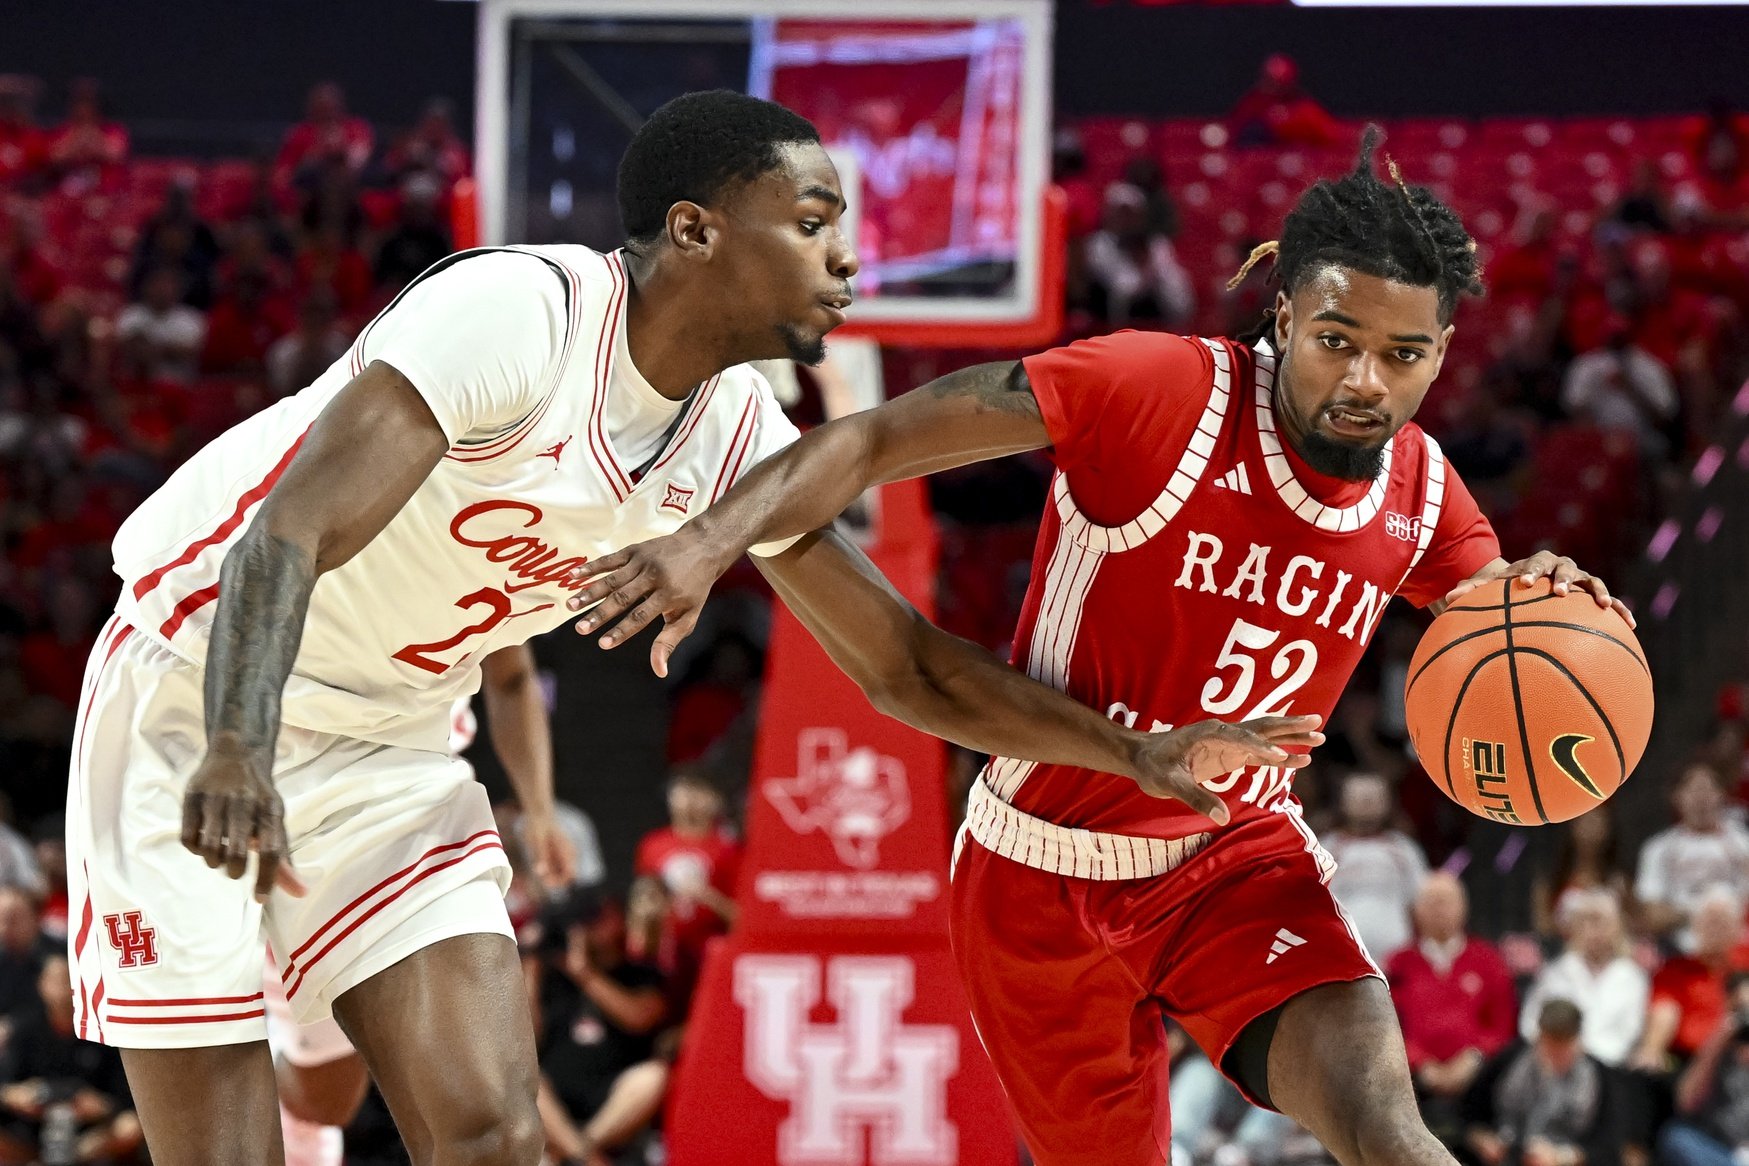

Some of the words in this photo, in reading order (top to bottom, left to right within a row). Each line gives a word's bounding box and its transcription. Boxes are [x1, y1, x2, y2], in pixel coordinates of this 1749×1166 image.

[391, 587, 555, 675] 2
[1200, 617, 1318, 723] 52
[1472, 739, 1525, 824] ELITE
[103, 911, 158, 968] UH
[732, 953, 960, 1166] UH
